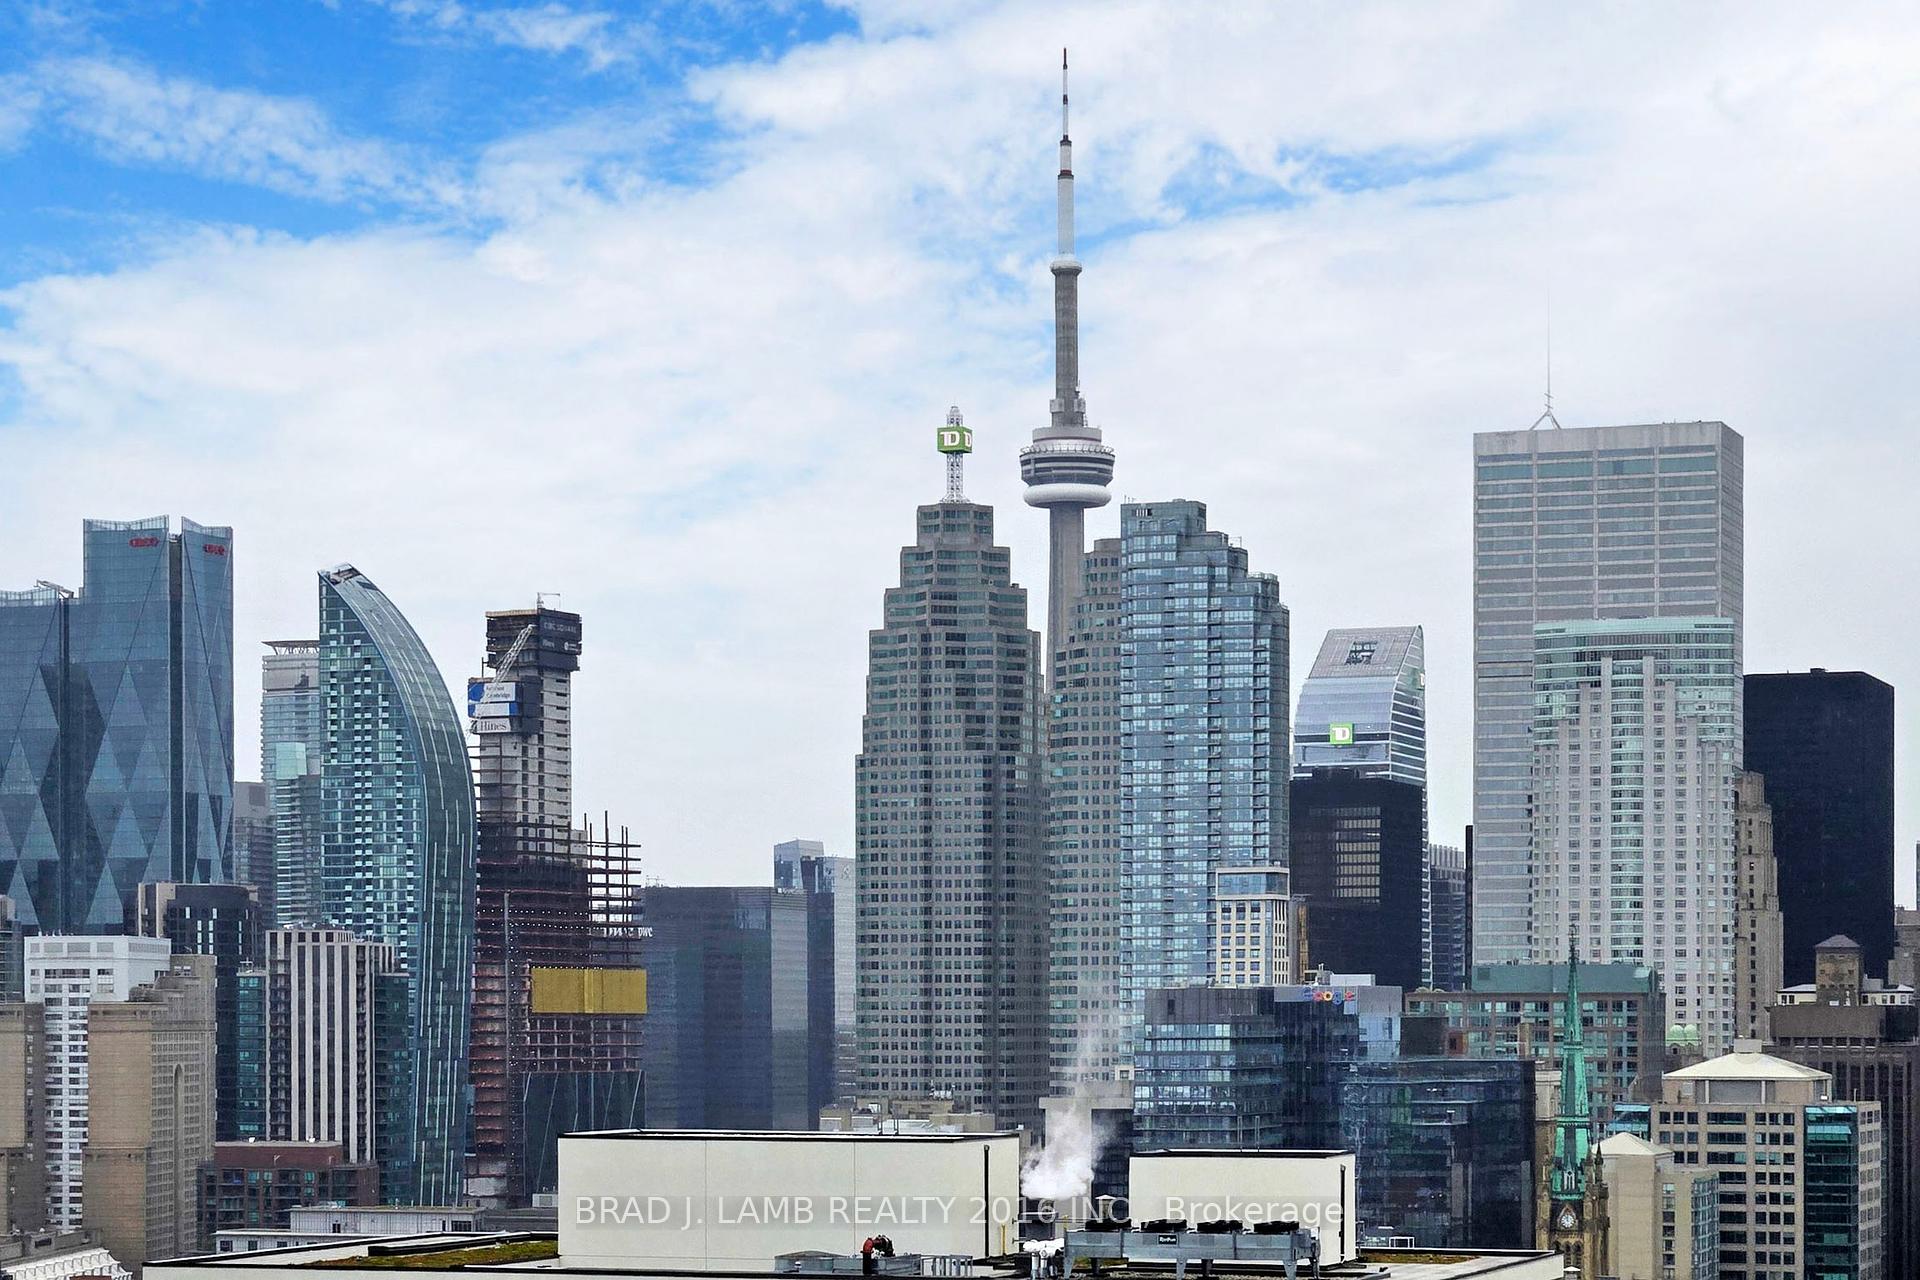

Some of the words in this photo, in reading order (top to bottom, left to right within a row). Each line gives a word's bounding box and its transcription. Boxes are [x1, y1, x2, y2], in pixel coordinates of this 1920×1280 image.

[940, 431, 960, 447] TD
[480, 721, 507, 731] Hines
[1332, 727, 1350, 741] TD
